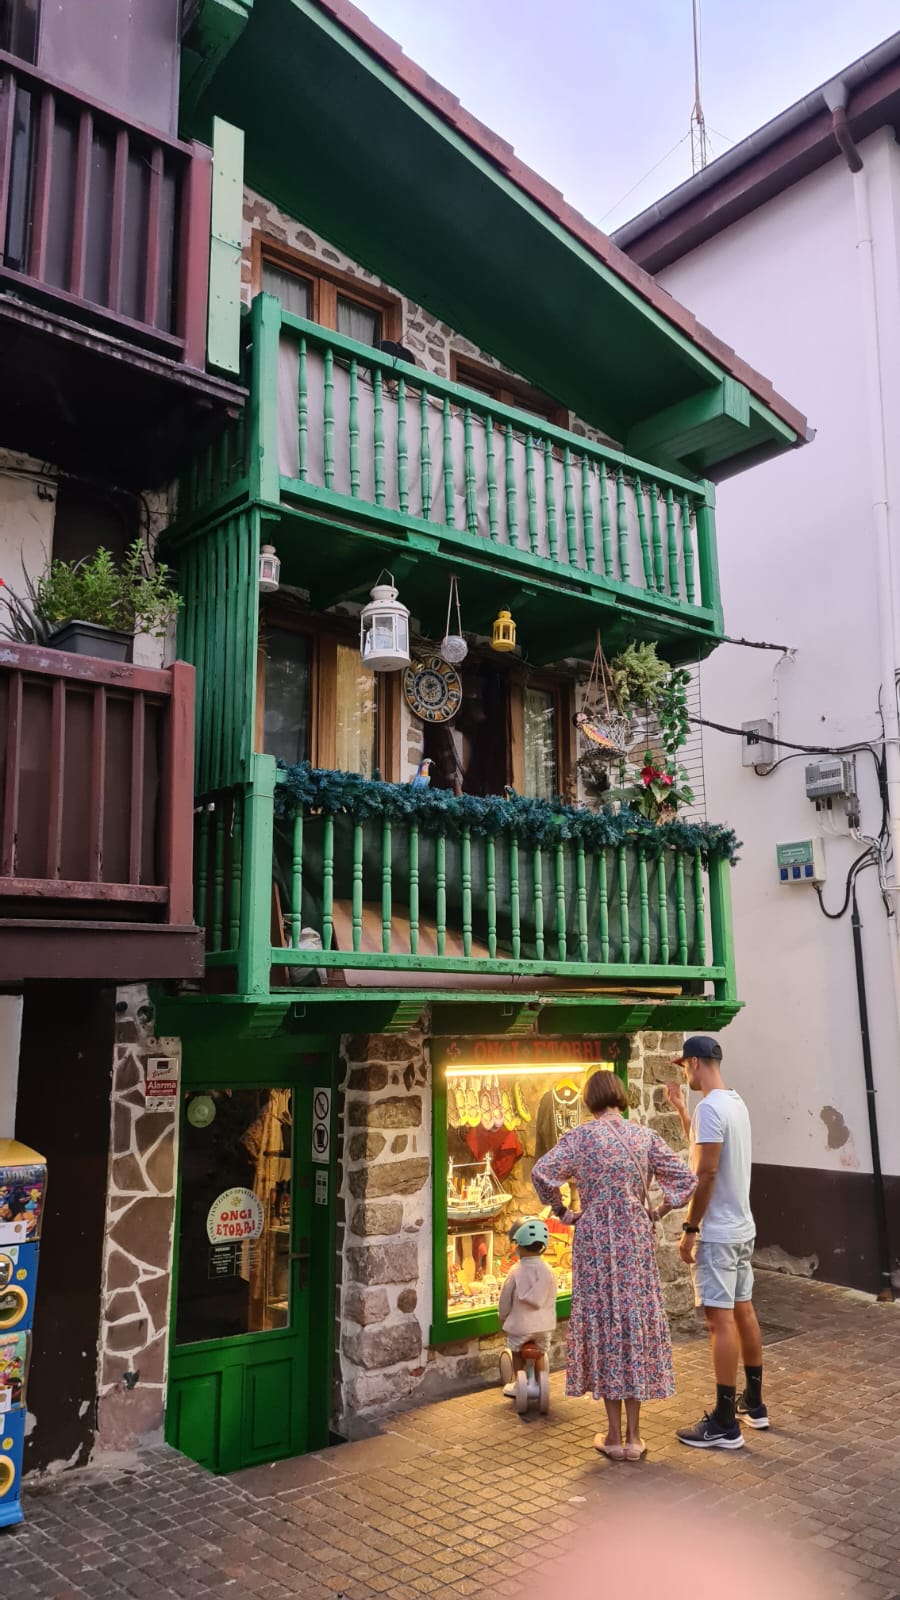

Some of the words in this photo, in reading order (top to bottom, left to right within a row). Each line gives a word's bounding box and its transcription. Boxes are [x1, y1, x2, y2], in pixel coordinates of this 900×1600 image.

[472, 1041, 518, 1060] ONGI
[533, 1040, 601, 1060] ETORRI
[147, 1081, 176, 1089] Alarma
[220, 1208, 252, 1221] ONGI
[215, 1220, 256, 1237] ETORRI
